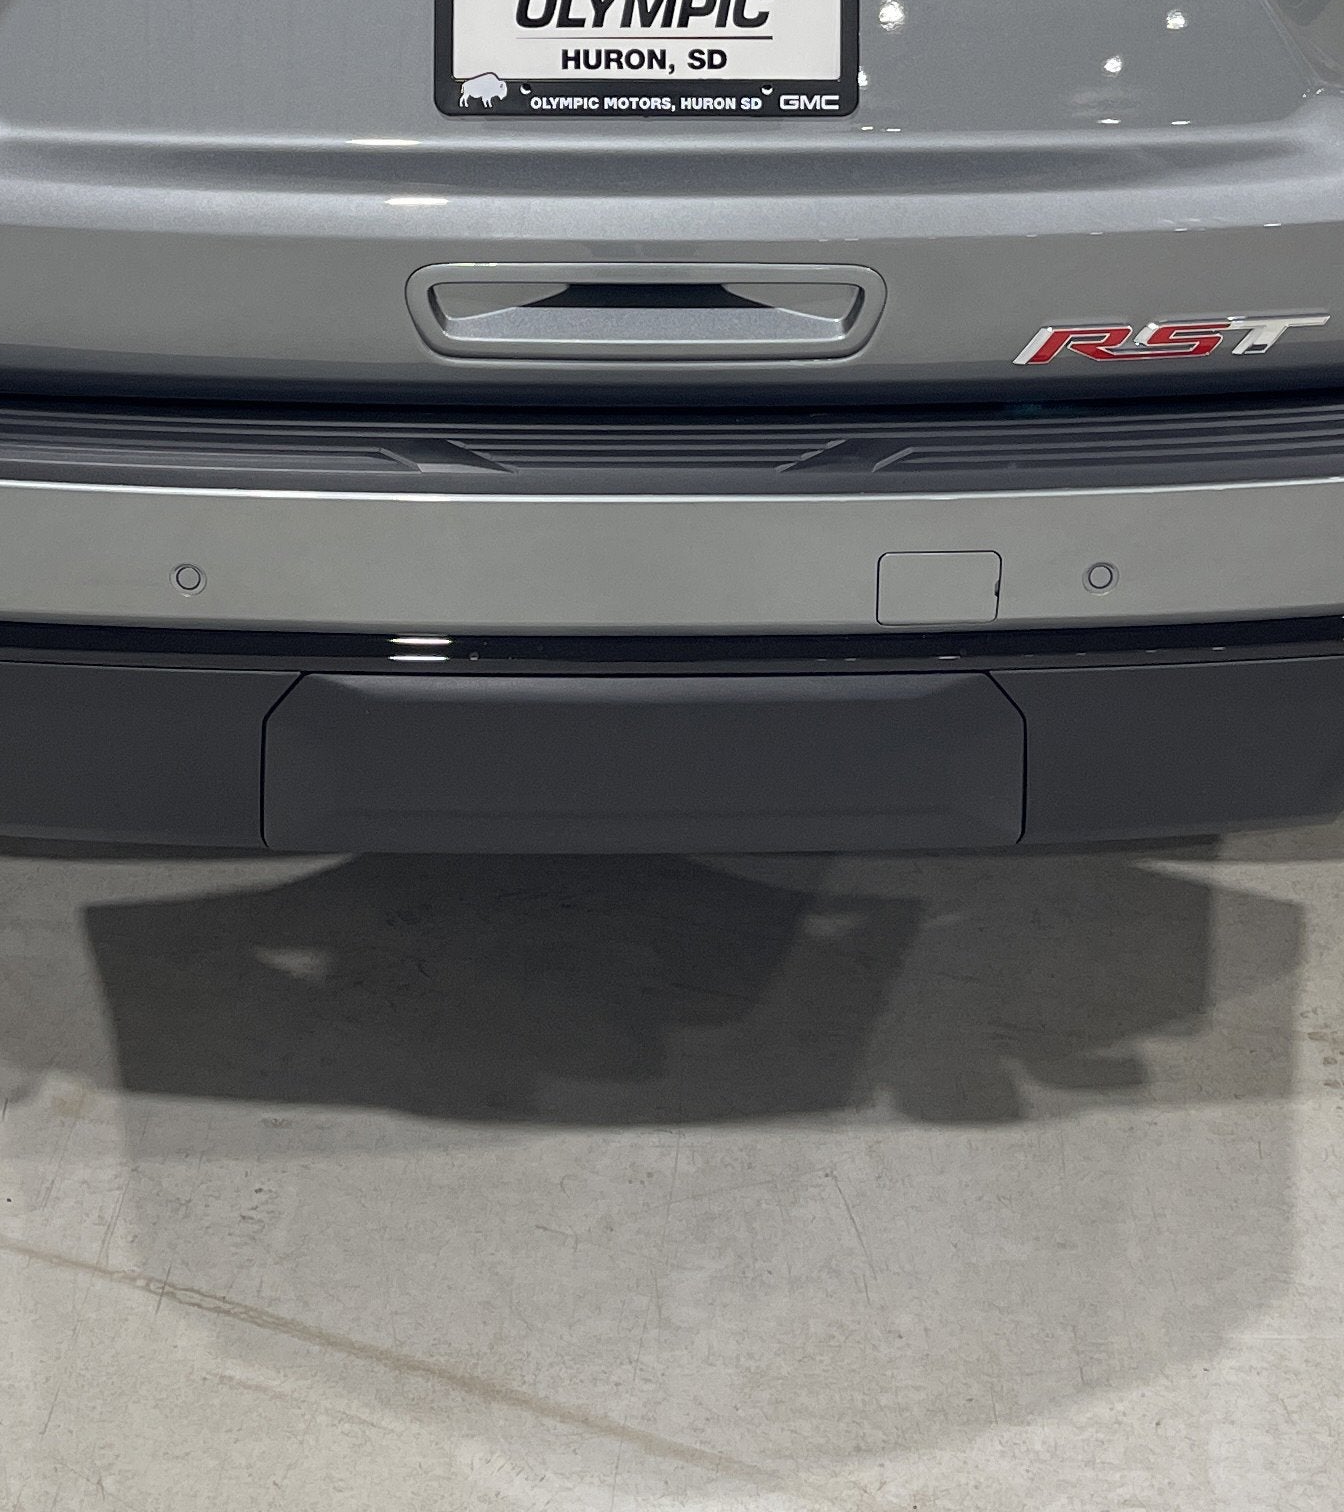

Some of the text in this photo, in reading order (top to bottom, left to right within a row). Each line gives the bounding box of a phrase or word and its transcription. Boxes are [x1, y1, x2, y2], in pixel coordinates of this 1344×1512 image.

[561, 49, 727, 73] HURON, SD
[530, 96, 762, 112] OLYMPIC MOTORS, HURON SD
[779, 94, 840, 110] GMC
[1012, 314, 1331, 365] RST
